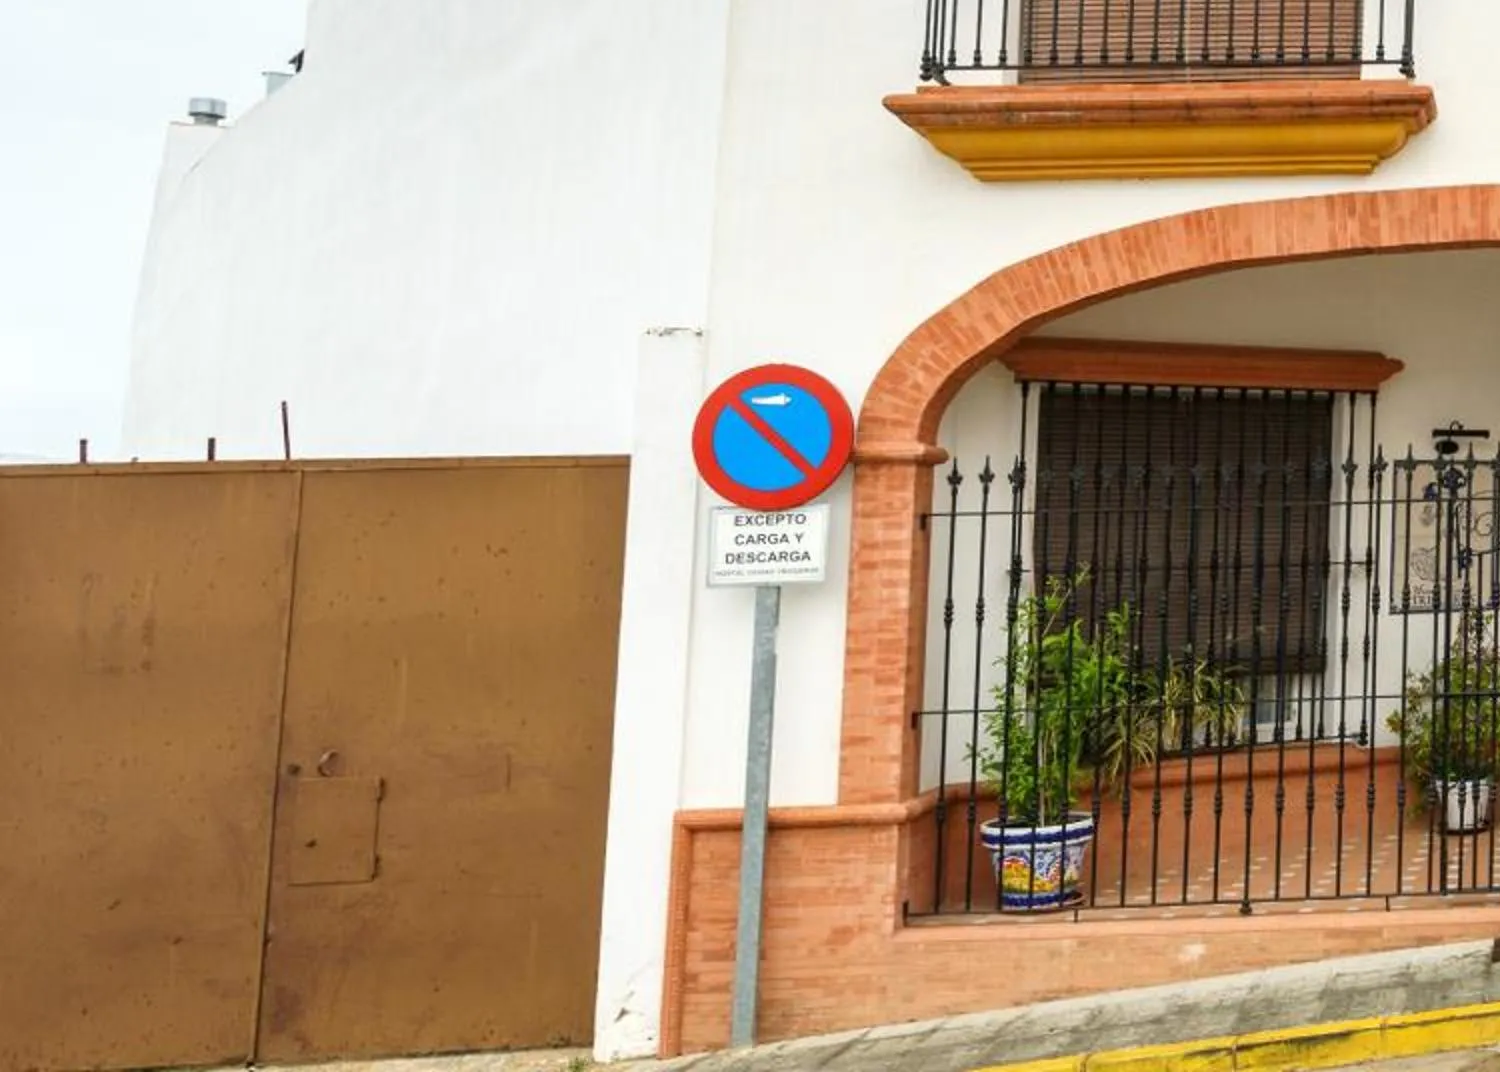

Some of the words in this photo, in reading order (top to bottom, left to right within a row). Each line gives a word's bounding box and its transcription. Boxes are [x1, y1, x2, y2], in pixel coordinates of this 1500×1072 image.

[734, 513, 808, 527] EXCEPTO
[734, 532, 791, 546] CARGA
[794, 531, 805, 544] Y
[725, 550, 812, 565] DESCARGA
